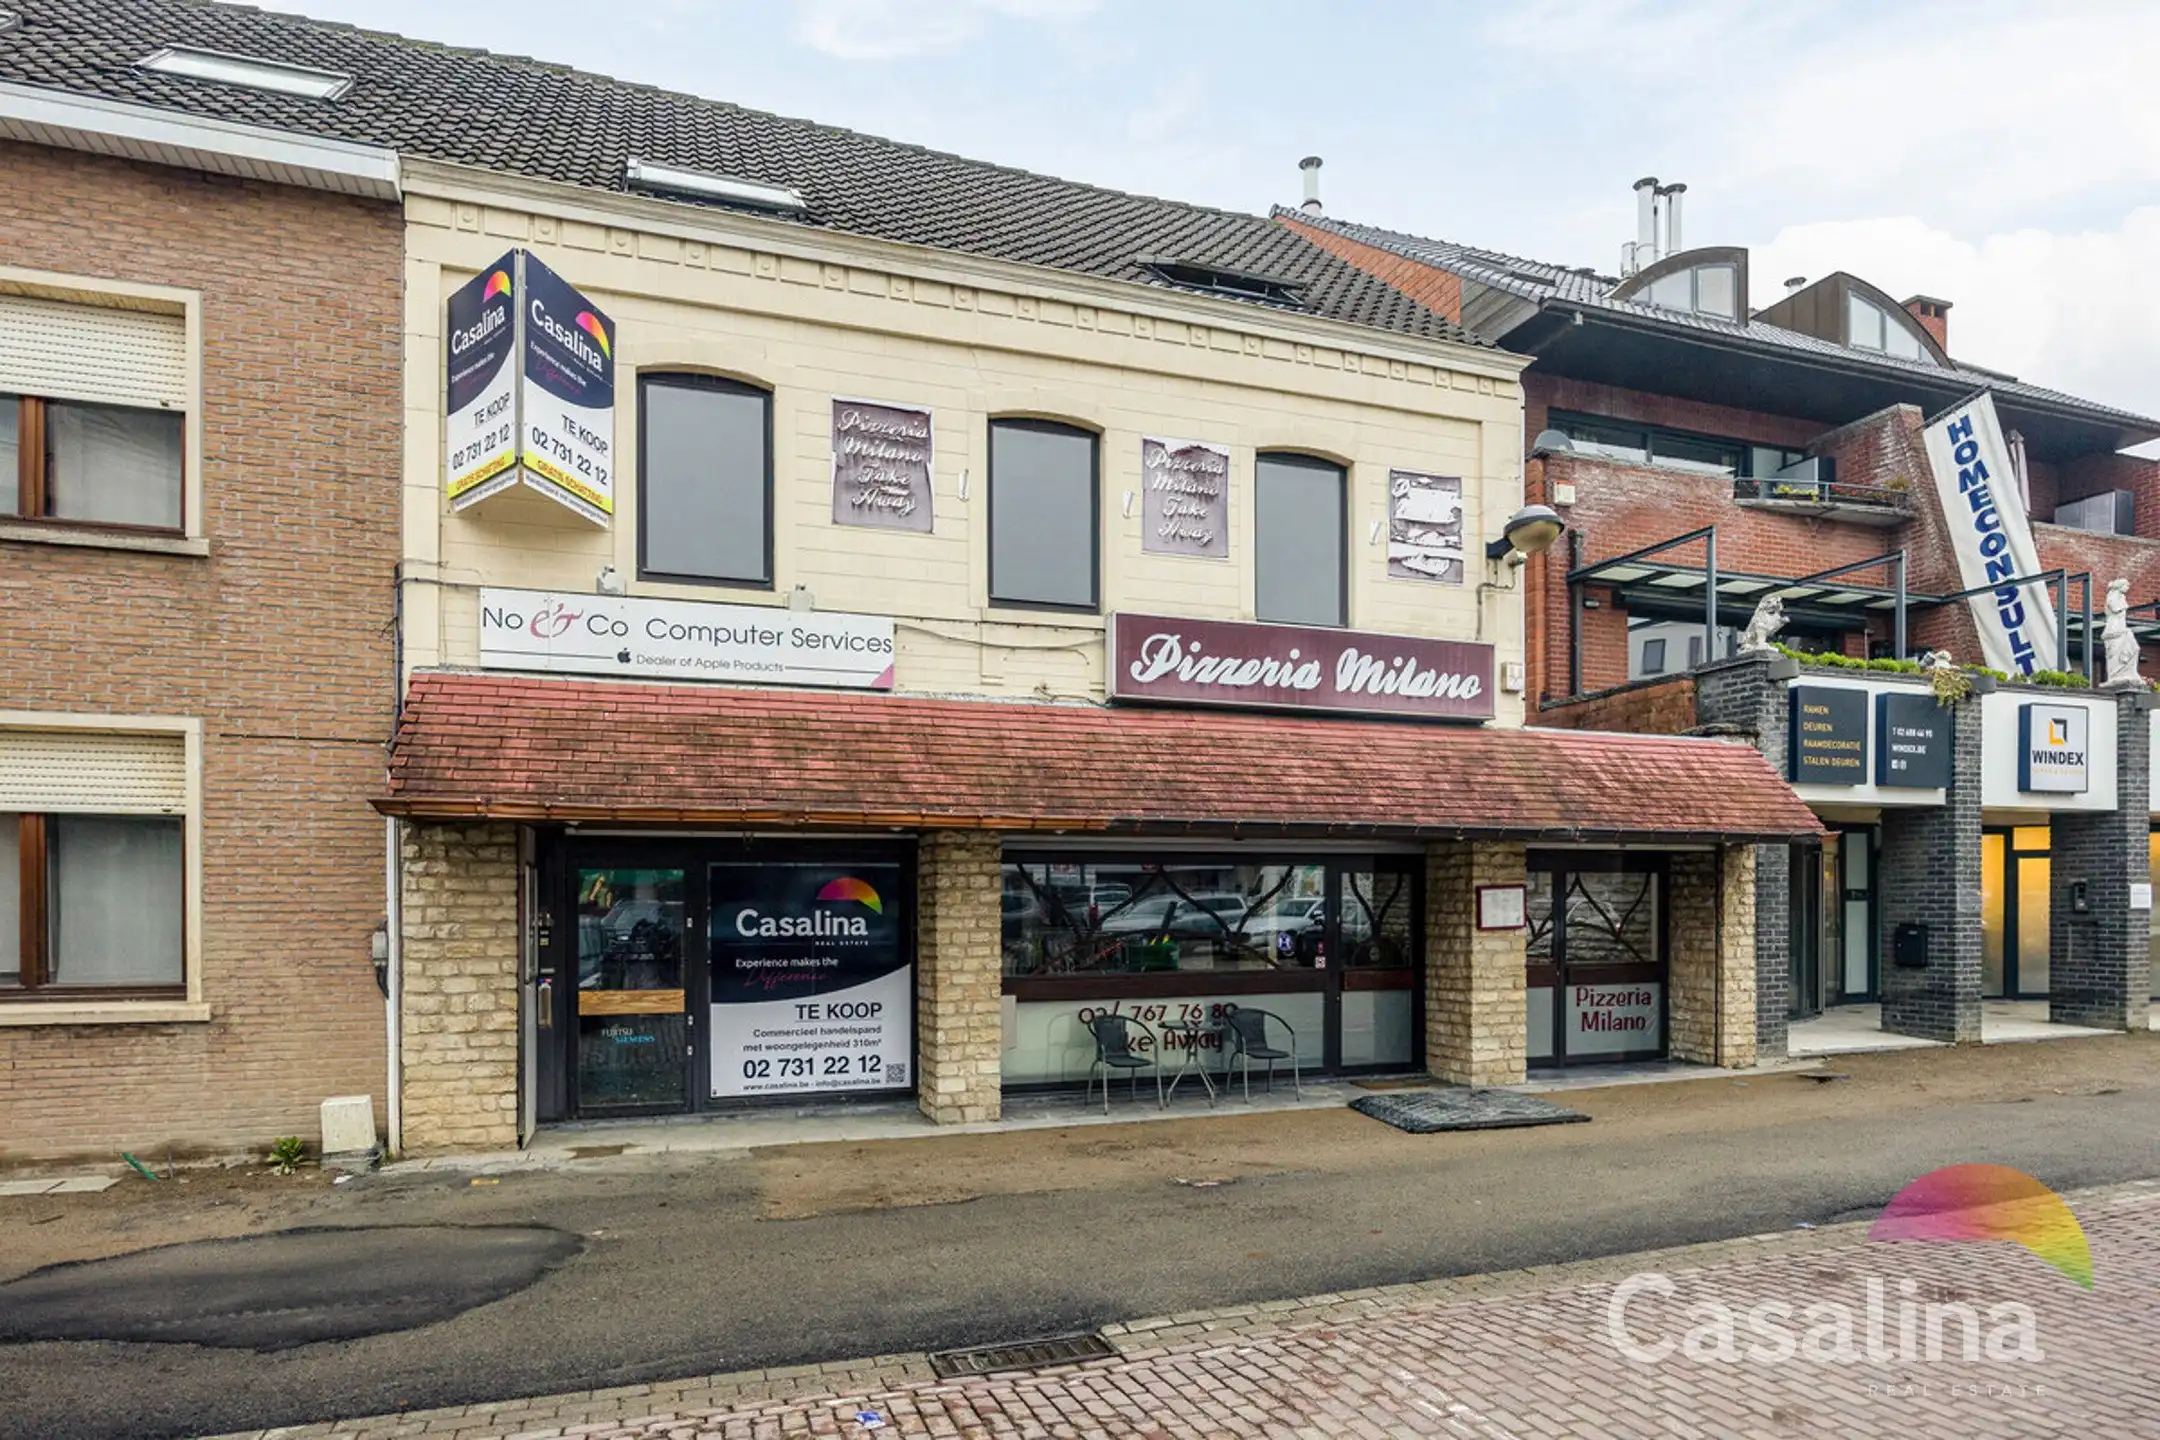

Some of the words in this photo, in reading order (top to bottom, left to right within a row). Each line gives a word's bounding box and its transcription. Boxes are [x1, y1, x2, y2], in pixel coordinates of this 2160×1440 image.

[452, 305, 505, 354] Casalina
[532, 299, 602, 372] Casalina
[474, 408, 484, 426] TE
[487, 392, 510, 417] KOOP
[561, 413, 576, 435] TE
[578, 425, 608, 453] KOOP
[837, 408, 929, 438] Pizzeria
[452, 450, 464, 470] 02
[466, 440, 481, 463] 731
[484, 431, 496, 452] 22
[499, 424, 510, 443] 12
[532, 426, 548, 450] 02
[552, 438, 572, 465] 731
[577, 454, 591, 476] 22
[595, 466, 607, 486] 12
[843, 436, 924, 461] Milano
[857, 463, 911, 485] Take
[1152, 471, 1219, 496] Milano
[851, 486, 917, 516] Away
[1162, 496, 1208, 518] Take
[1158, 521, 1213, 547] Away
[1947, 414, 2036, 677] HOMECONSULT
[482, 607, 523, 630] No
[586, 613, 629, 637] Co
[645, 618, 784, 648] Computer
[791, 627, 892, 654] Services
[636, 653, 677, 666] Dealer
[679, 656, 692, 667] of
[694, 657, 731, 670] Apple
[733, 659, 784, 672] Products
[1130, 632, 1323, 690] Pizzeria
[1335, 647, 1482, 700] Milano
[1803, 721, 1833, 732] DEUREN
[1803, 755, 1830, 767] STALEN
[1831, 757, 1861, 768] DEUREN
[2032, 750, 2084, 766] WINDEX
[735, 908, 868, 937] Casalina
[735, 958, 789, 969] Experience
[790, 957, 820, 968] makes
[822, 956, 839, 967] the
[1575, 986, 1652, 1007] Pizzeria
[795, 1004, 820, 1020] TE
[827, 1002, 883, 1019] KOOP
[1131, 1005, 1167, 1024] 767
[1178, 1004, 1203, 1021] 76
[1581, 1011, 1647, 1032] Milano
[616, 1035, 656, 1044] SIEMENS
[753, 1027, 818, 1038] Commercieel
[819, 1025, 882, 1037] handelspand
[743, 1043, 762, 1052] met
[765, 1039, 850, 1052] woongelegenheid
[743, 1059, 770, 1078] 02
[777, 1057, 814, 1077] 731
[823, 1055, 850, 1075] 22
[858, 1054, 881, 1073] 12
[743, 1082, 809, 1090] www.casalina.be
